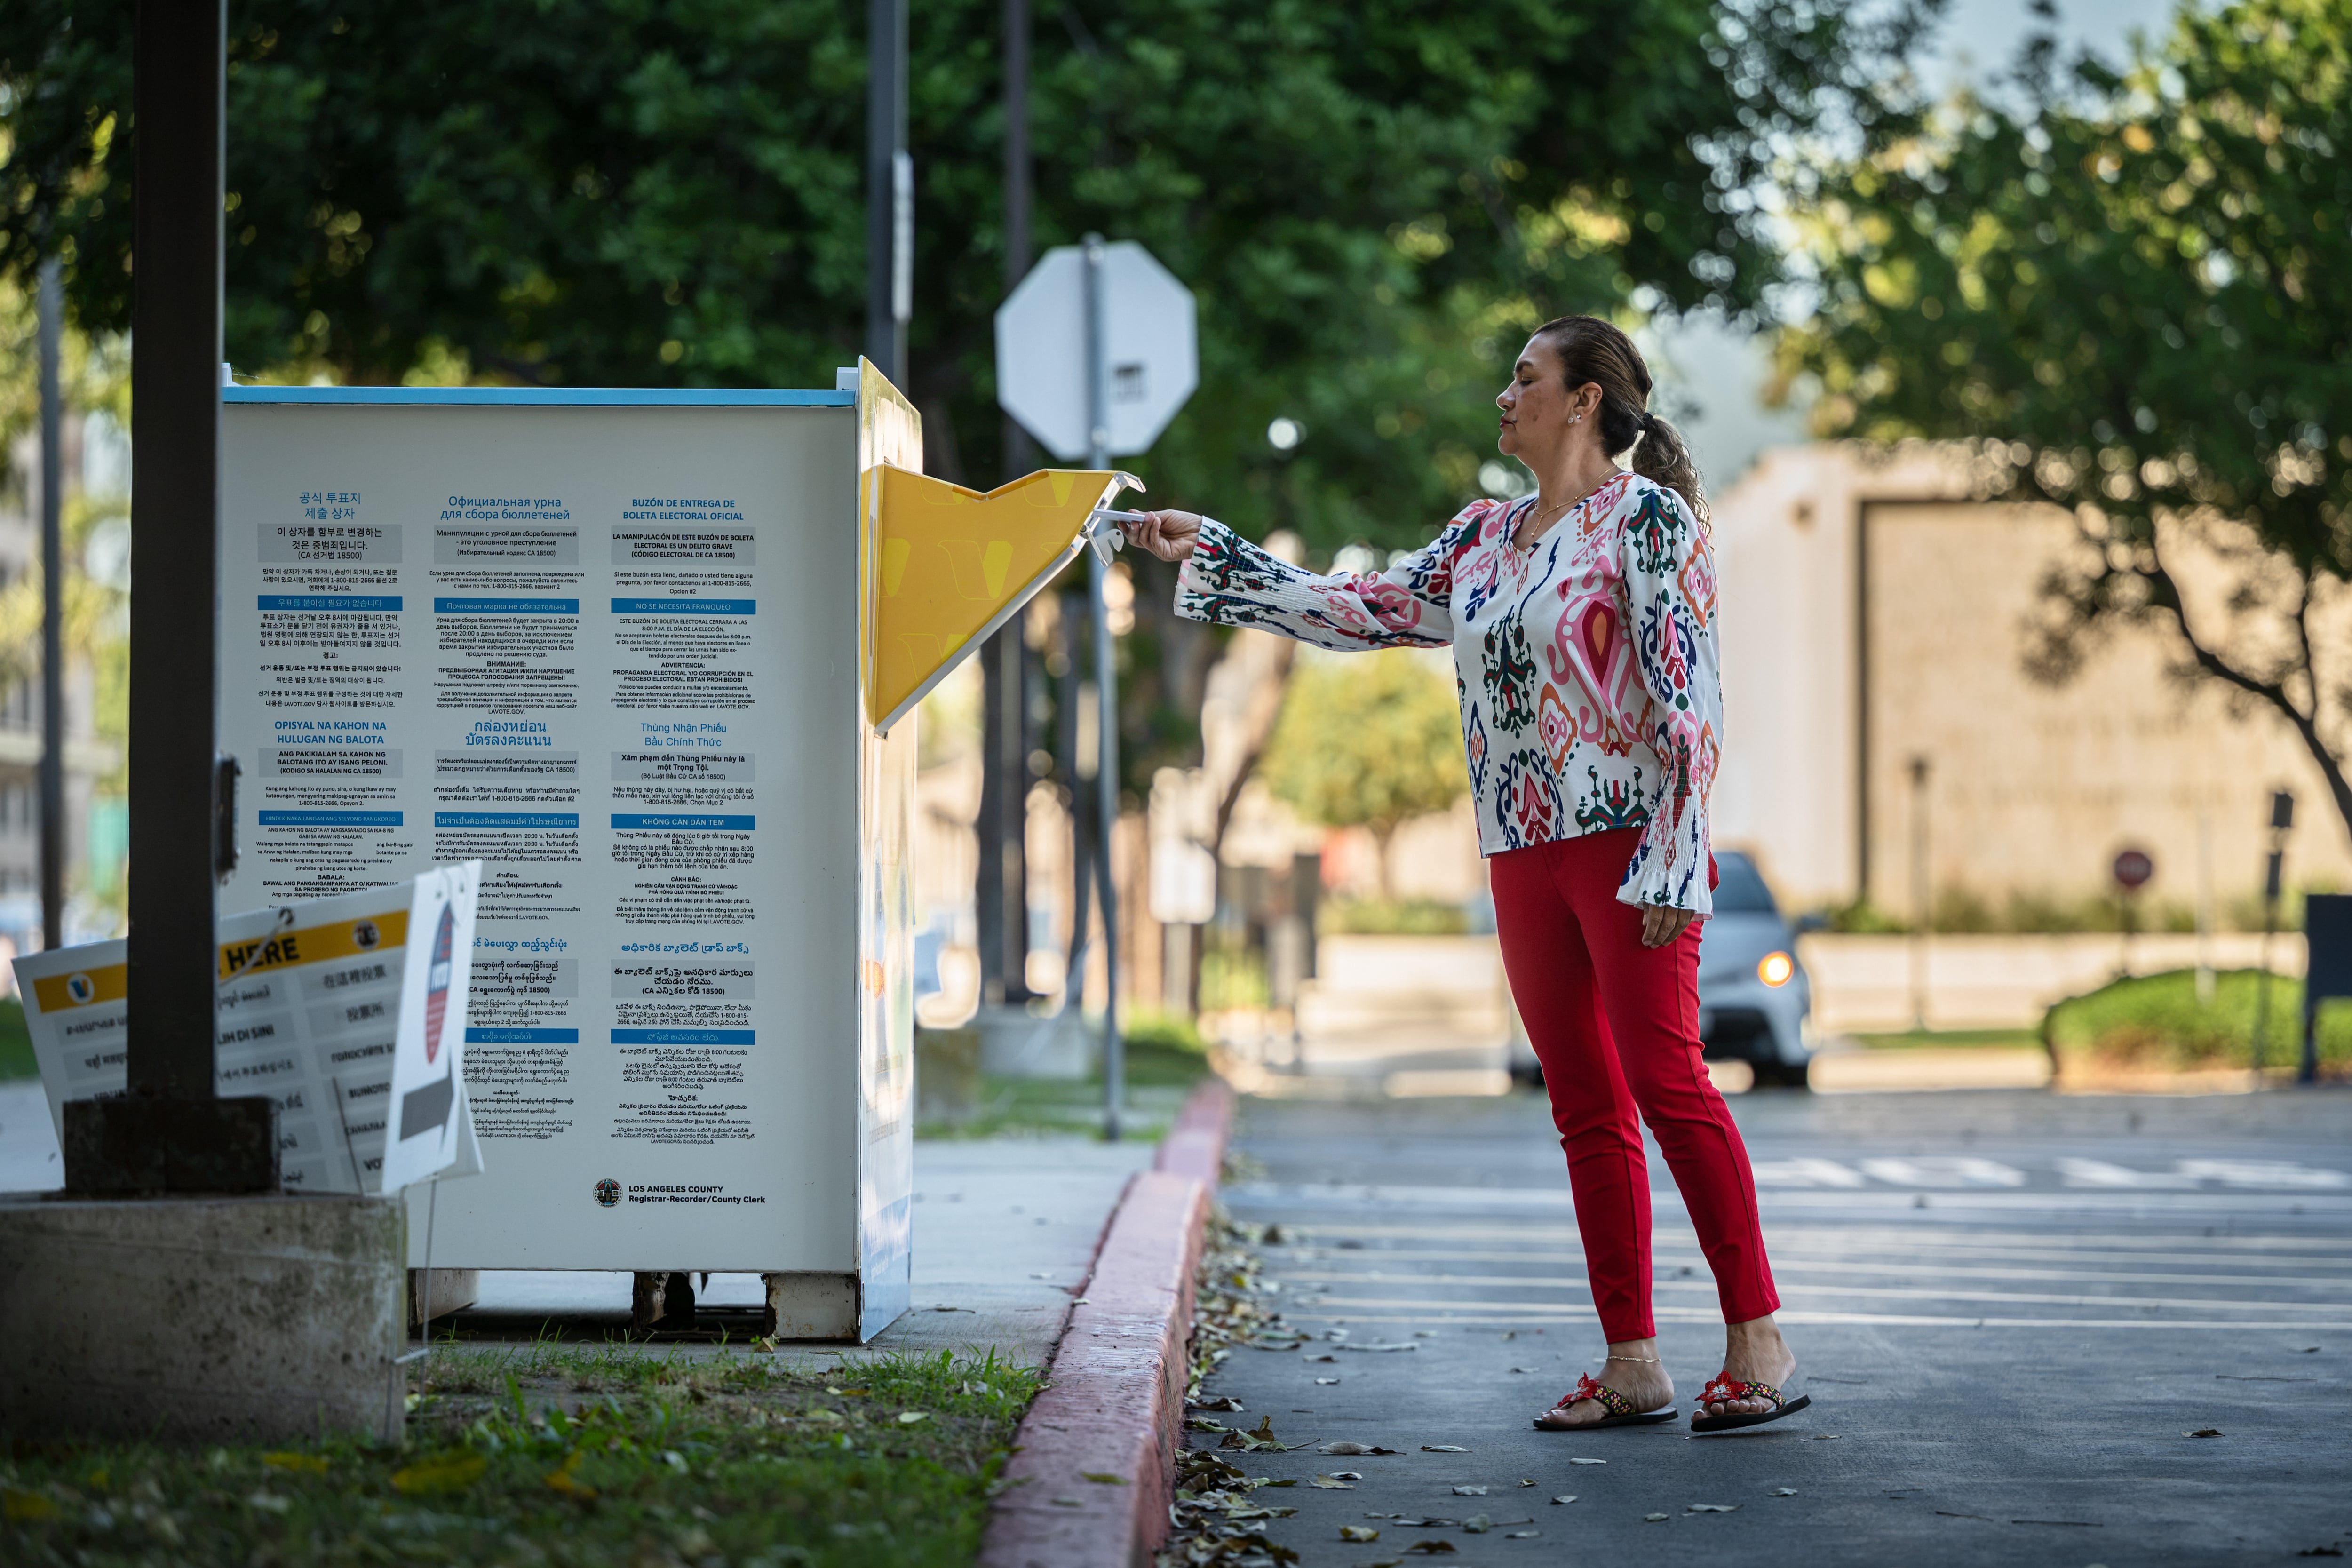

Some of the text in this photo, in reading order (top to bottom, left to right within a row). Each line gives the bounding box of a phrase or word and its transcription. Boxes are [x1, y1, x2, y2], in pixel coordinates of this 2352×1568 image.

[299, 491, 360, 505] 공식 투표지
[448, 496, 561, 509] Официальная урна
[632, 497, 663, 507] BUZÓN
[305, 507, 355, 520] 제출 상자
[440, 509, 570, 521] для сбора бюллетеней
[277, 526, 383, 538] 이 상자를 함부로 변경하는
[292, 540, 368, 549] 것은 중범죄입니다.
[298, 551, 311, 560] (CA
[337, 551, 362, 560] 18500)
[334, 722, 369, 730] KAHON
[475, 719, 547, 732] กล่องหย่อน
[640, 722, 727, 734] Thùng Nhận Phiếu
[278, 735, 326, 743] HULUGAN
[465, 732, 552, 746] บัตรลงคะแนน
[645, 735, 722, 747] Bầu Chính Thức
[621, 942, 749, 954] అధికారిక బ్యాలెట్ డ్రాప్ బాక్స్
[227, 937, 301, 972] HERE
[628, 1195, 742, 1204] Registrar-Recorder/County
